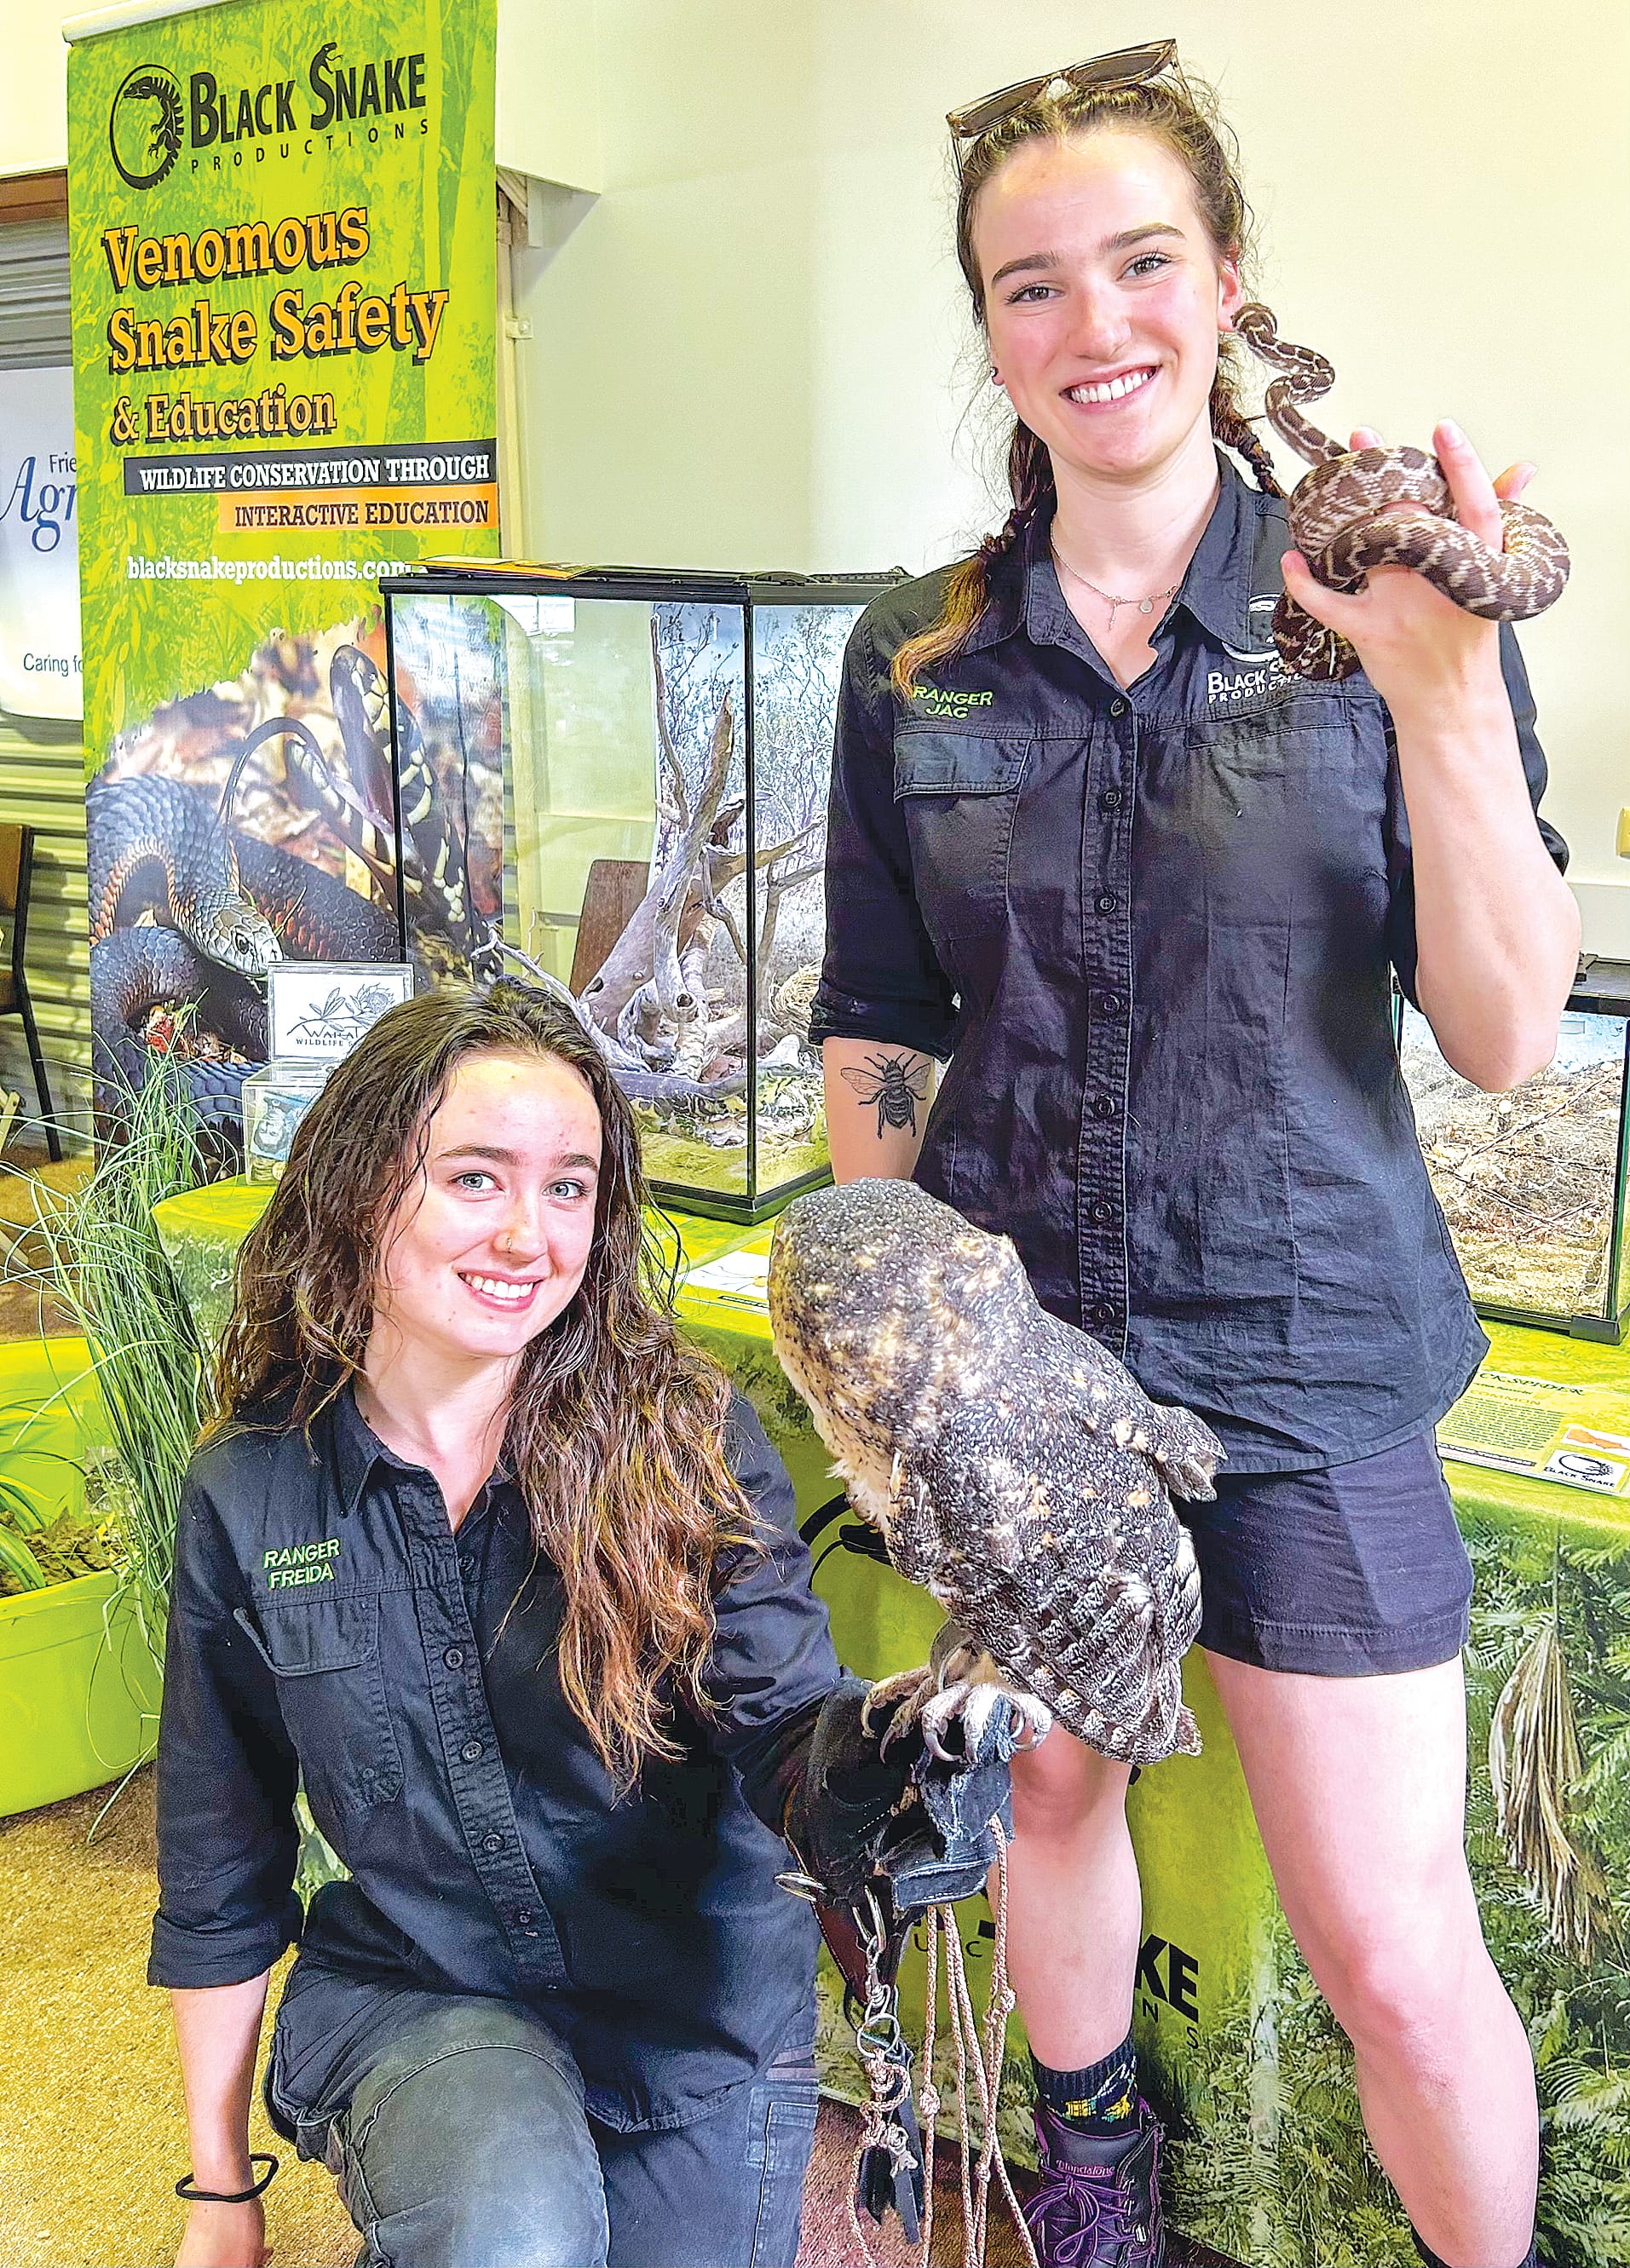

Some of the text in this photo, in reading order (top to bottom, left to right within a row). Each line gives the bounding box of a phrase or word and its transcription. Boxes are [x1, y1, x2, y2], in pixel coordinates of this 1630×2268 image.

[190, 42, 426, 148] BLACK SNAKE
[192, 118, 428, 174] PRODUCTIONS
[101, 207, 369, 293] Venomous
[109, 281, 449, 374] Snake Safety
[111, 383, 337, 446] & Education
[140, 454, 490, 491] WILDLIFE CONSERVATION THROUGH
[234, 499, 489, 527] INTERACTIVE EDUCATION
[127, 555, 429, 585] blacksnakeproductions.com
[23, 653, 68, 676] Caring
[913, 685, 995, 707] RANGER
[1207, 669, 1267, 695] BLACK
[925, 704, 970, 720] JAC
[1470, 1389, 1541, 1406] COMMON
[262, 1537, 341, 1569] RANGER
[268, 1562, 337, 1591] FREIDA
